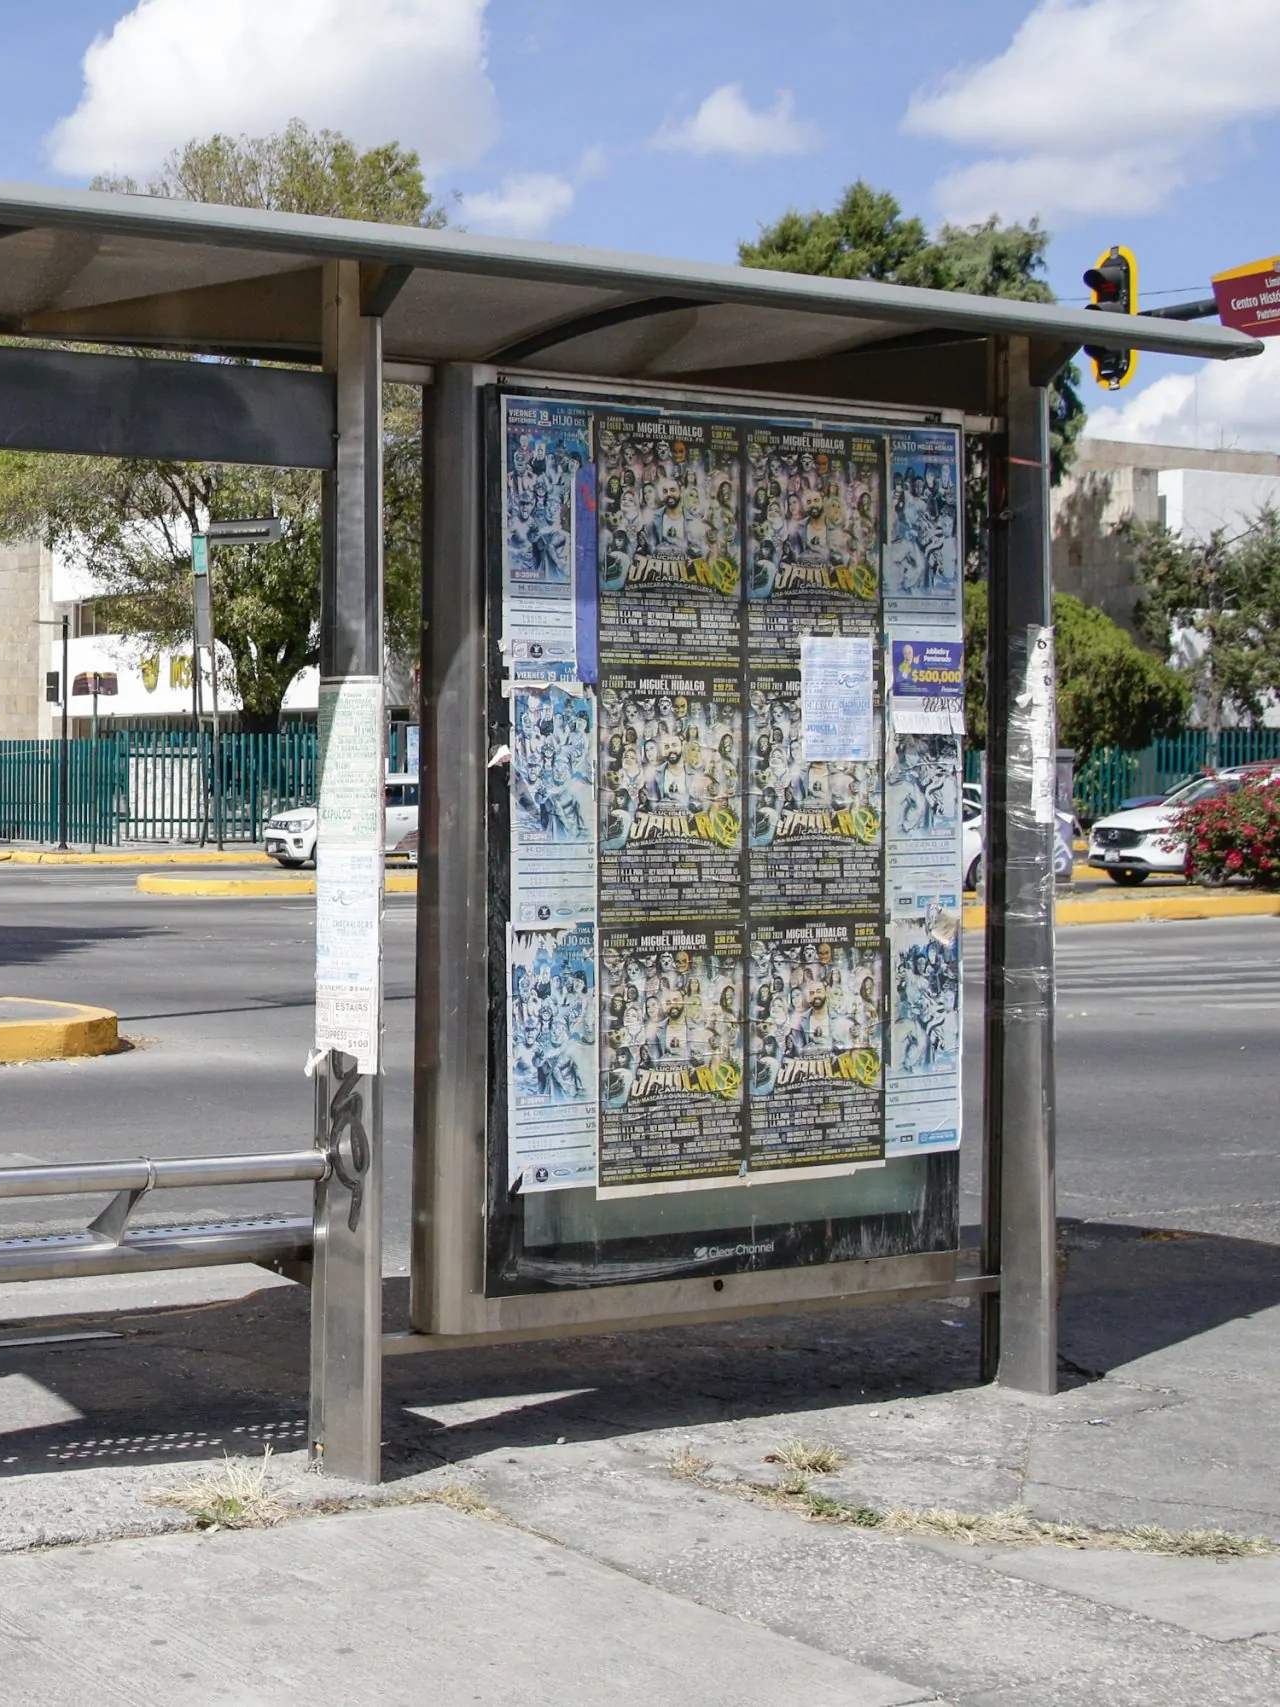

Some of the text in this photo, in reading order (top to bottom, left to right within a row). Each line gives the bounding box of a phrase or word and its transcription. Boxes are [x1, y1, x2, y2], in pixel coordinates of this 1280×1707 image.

[1231, 296, 1258, 310] Centro
[508, 409, 549, 421] VIERNES 19
[552, 414, 586, 427] HIJO DEL
[637, 422, 666, 435] MIGUEL
[669, 425, 703, 438] HIDALGO
[783, 435, 811, 447] MIGUEL
[812, 438, 844, 450] HIDALGO
[892, 440, 916, 452] SANTO
[628, 554, 715, 584] JAULA
[775, 562, 855, 589] JAULA
[517, 671, 556, 681] VIERNES 19
[912, 669, 961, 684] $500,000
[640, 679, 669, 690] MIGUEL
[671, 680, 705, 691] HIDALGO
[630, 811, 715, 839] JAULA
[776, 809, 856, 836] JAULA
[641, 935, 670, 947] MIGUEL
[672, 934, 706, 945] HIDALGO
[786, 928, 814, 939] MIGUEL
[815, 927, 847, 938] HIDALGO
[579, 937, 591, 945] DEL
[777, 1052, 857, 1084] JAULA
[631, 1064, 718, 1097] JAULA
[709, 1241, 775, 1258] Clear Channel
